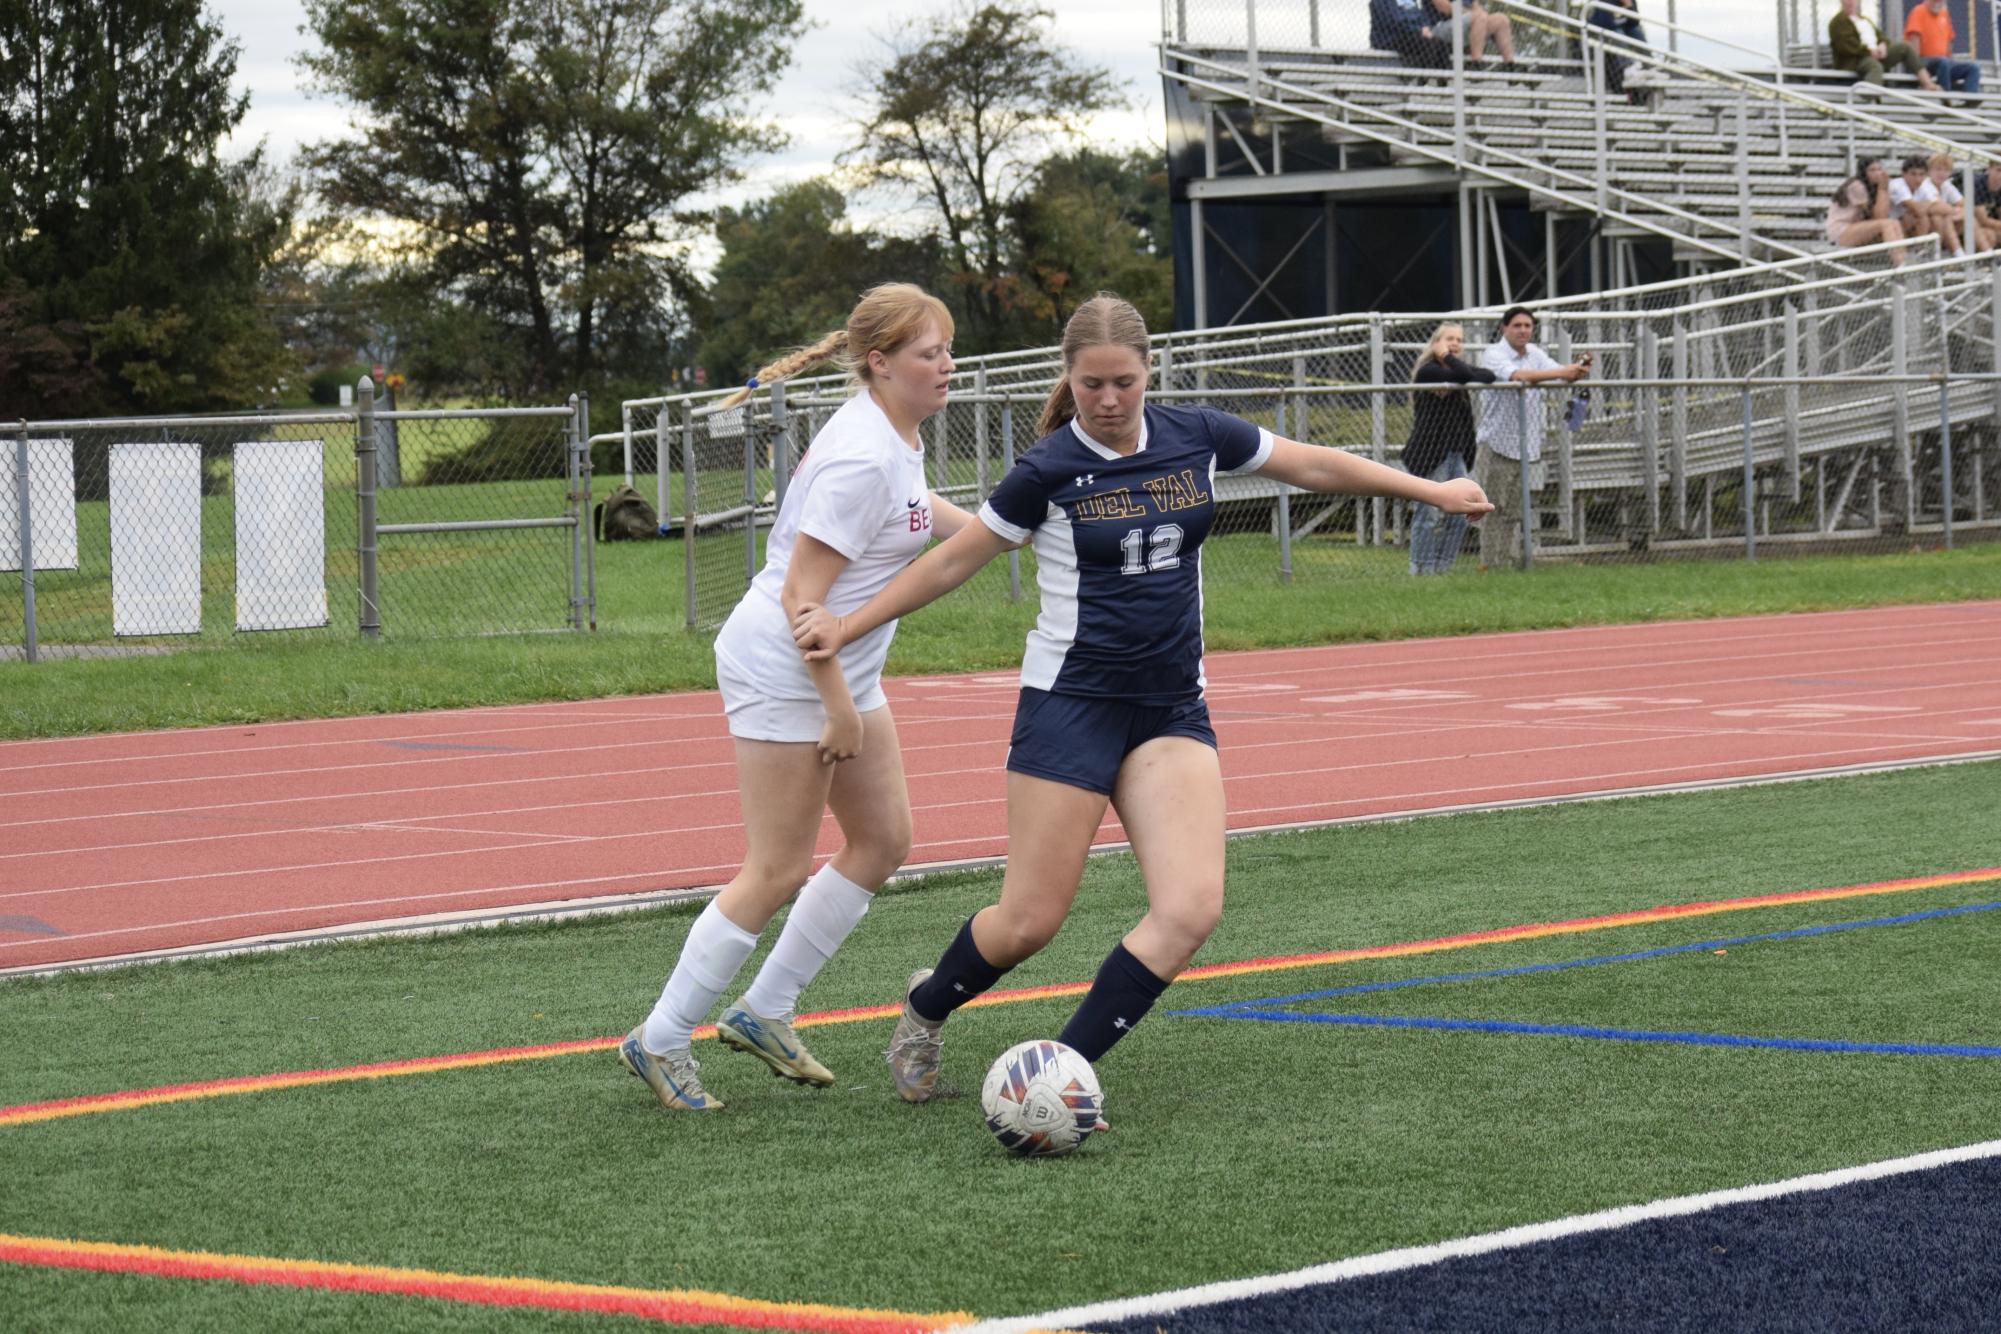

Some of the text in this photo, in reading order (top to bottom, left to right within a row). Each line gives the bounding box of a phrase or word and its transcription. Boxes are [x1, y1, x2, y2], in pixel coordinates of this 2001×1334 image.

[1143, 469, 1209, 513] VAL
[910, 508, 931, 532] BE
[1120, 523, 1184, 575] 12
